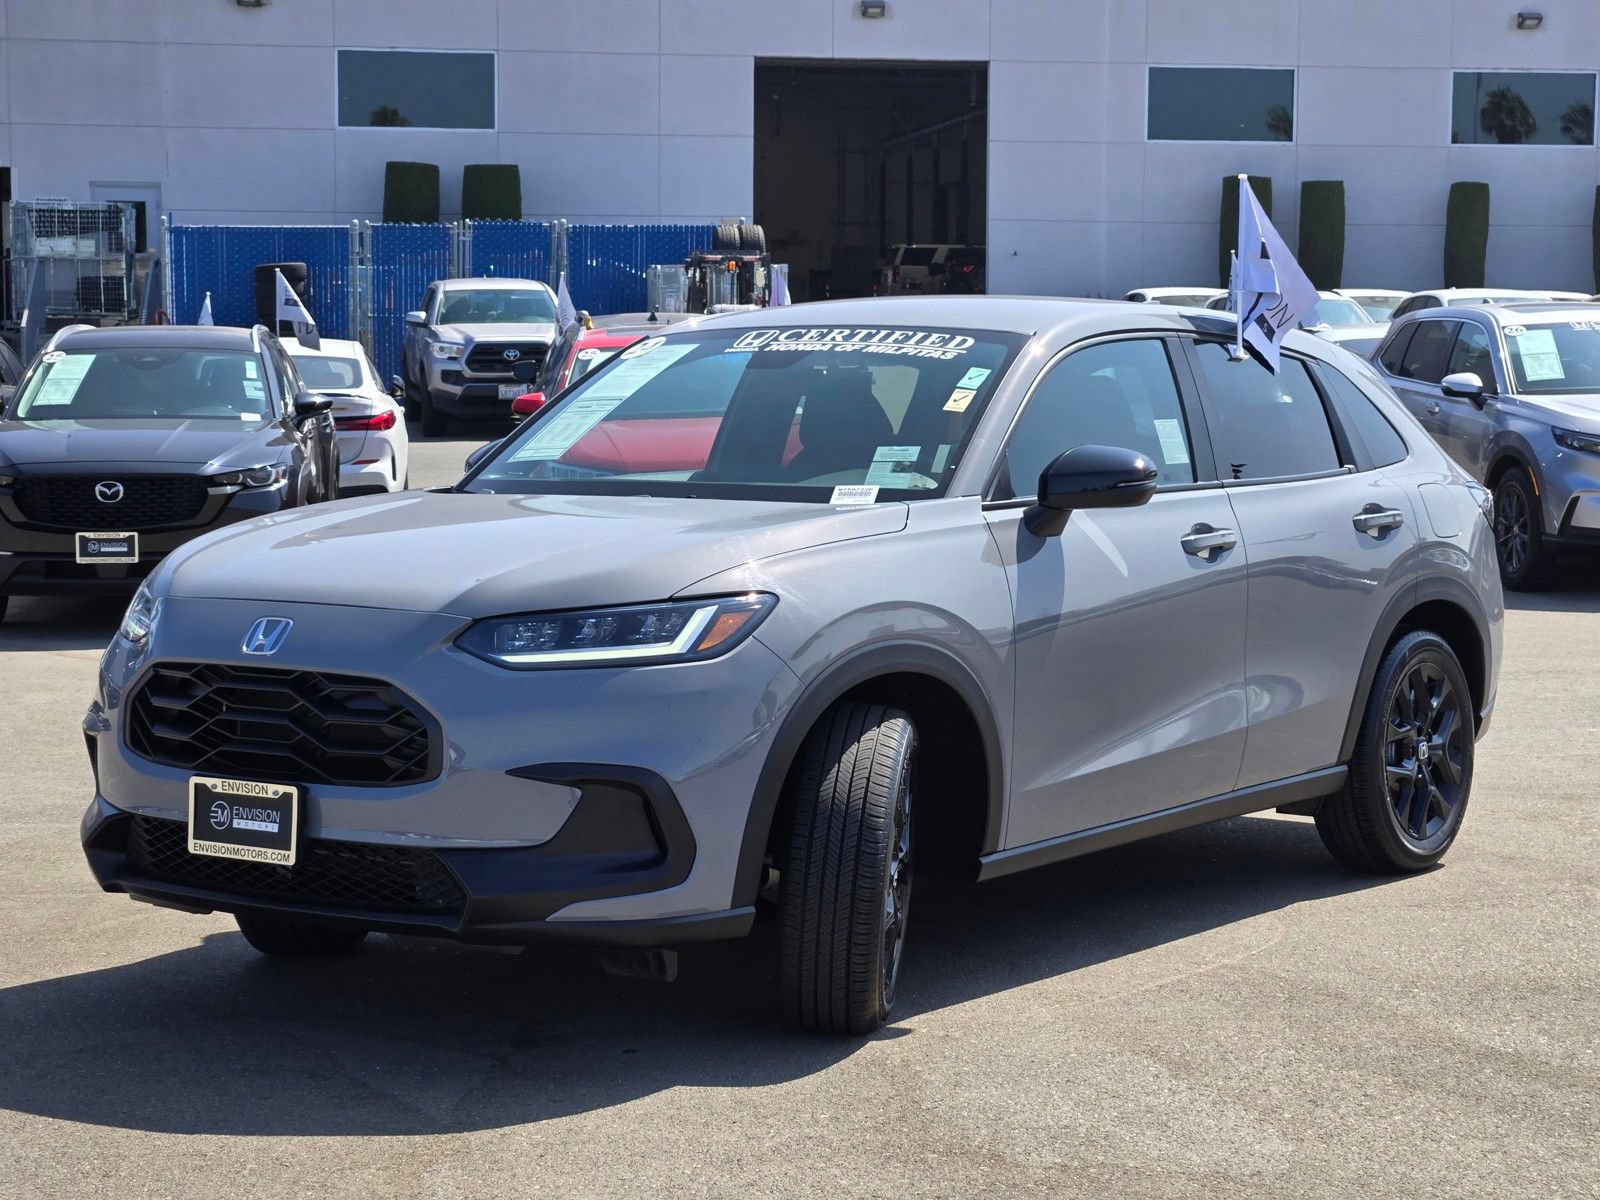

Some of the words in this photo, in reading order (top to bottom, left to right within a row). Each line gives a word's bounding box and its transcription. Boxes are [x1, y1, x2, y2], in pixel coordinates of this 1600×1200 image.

[778, 328, 975, 350] CERTIFIED
[764, 343, 833, 352] HONDA
[834, 344, 865, 352] OF
[862, 345, 958, 360] MILPITAS
[221, 780, 269, 796] ENVISION
[233, 806, 280, 823] ENVISION
[236, 821, 275, 830] MOTORS
[193, 843, 290, 863] ENVISIONMOTORS.COM
